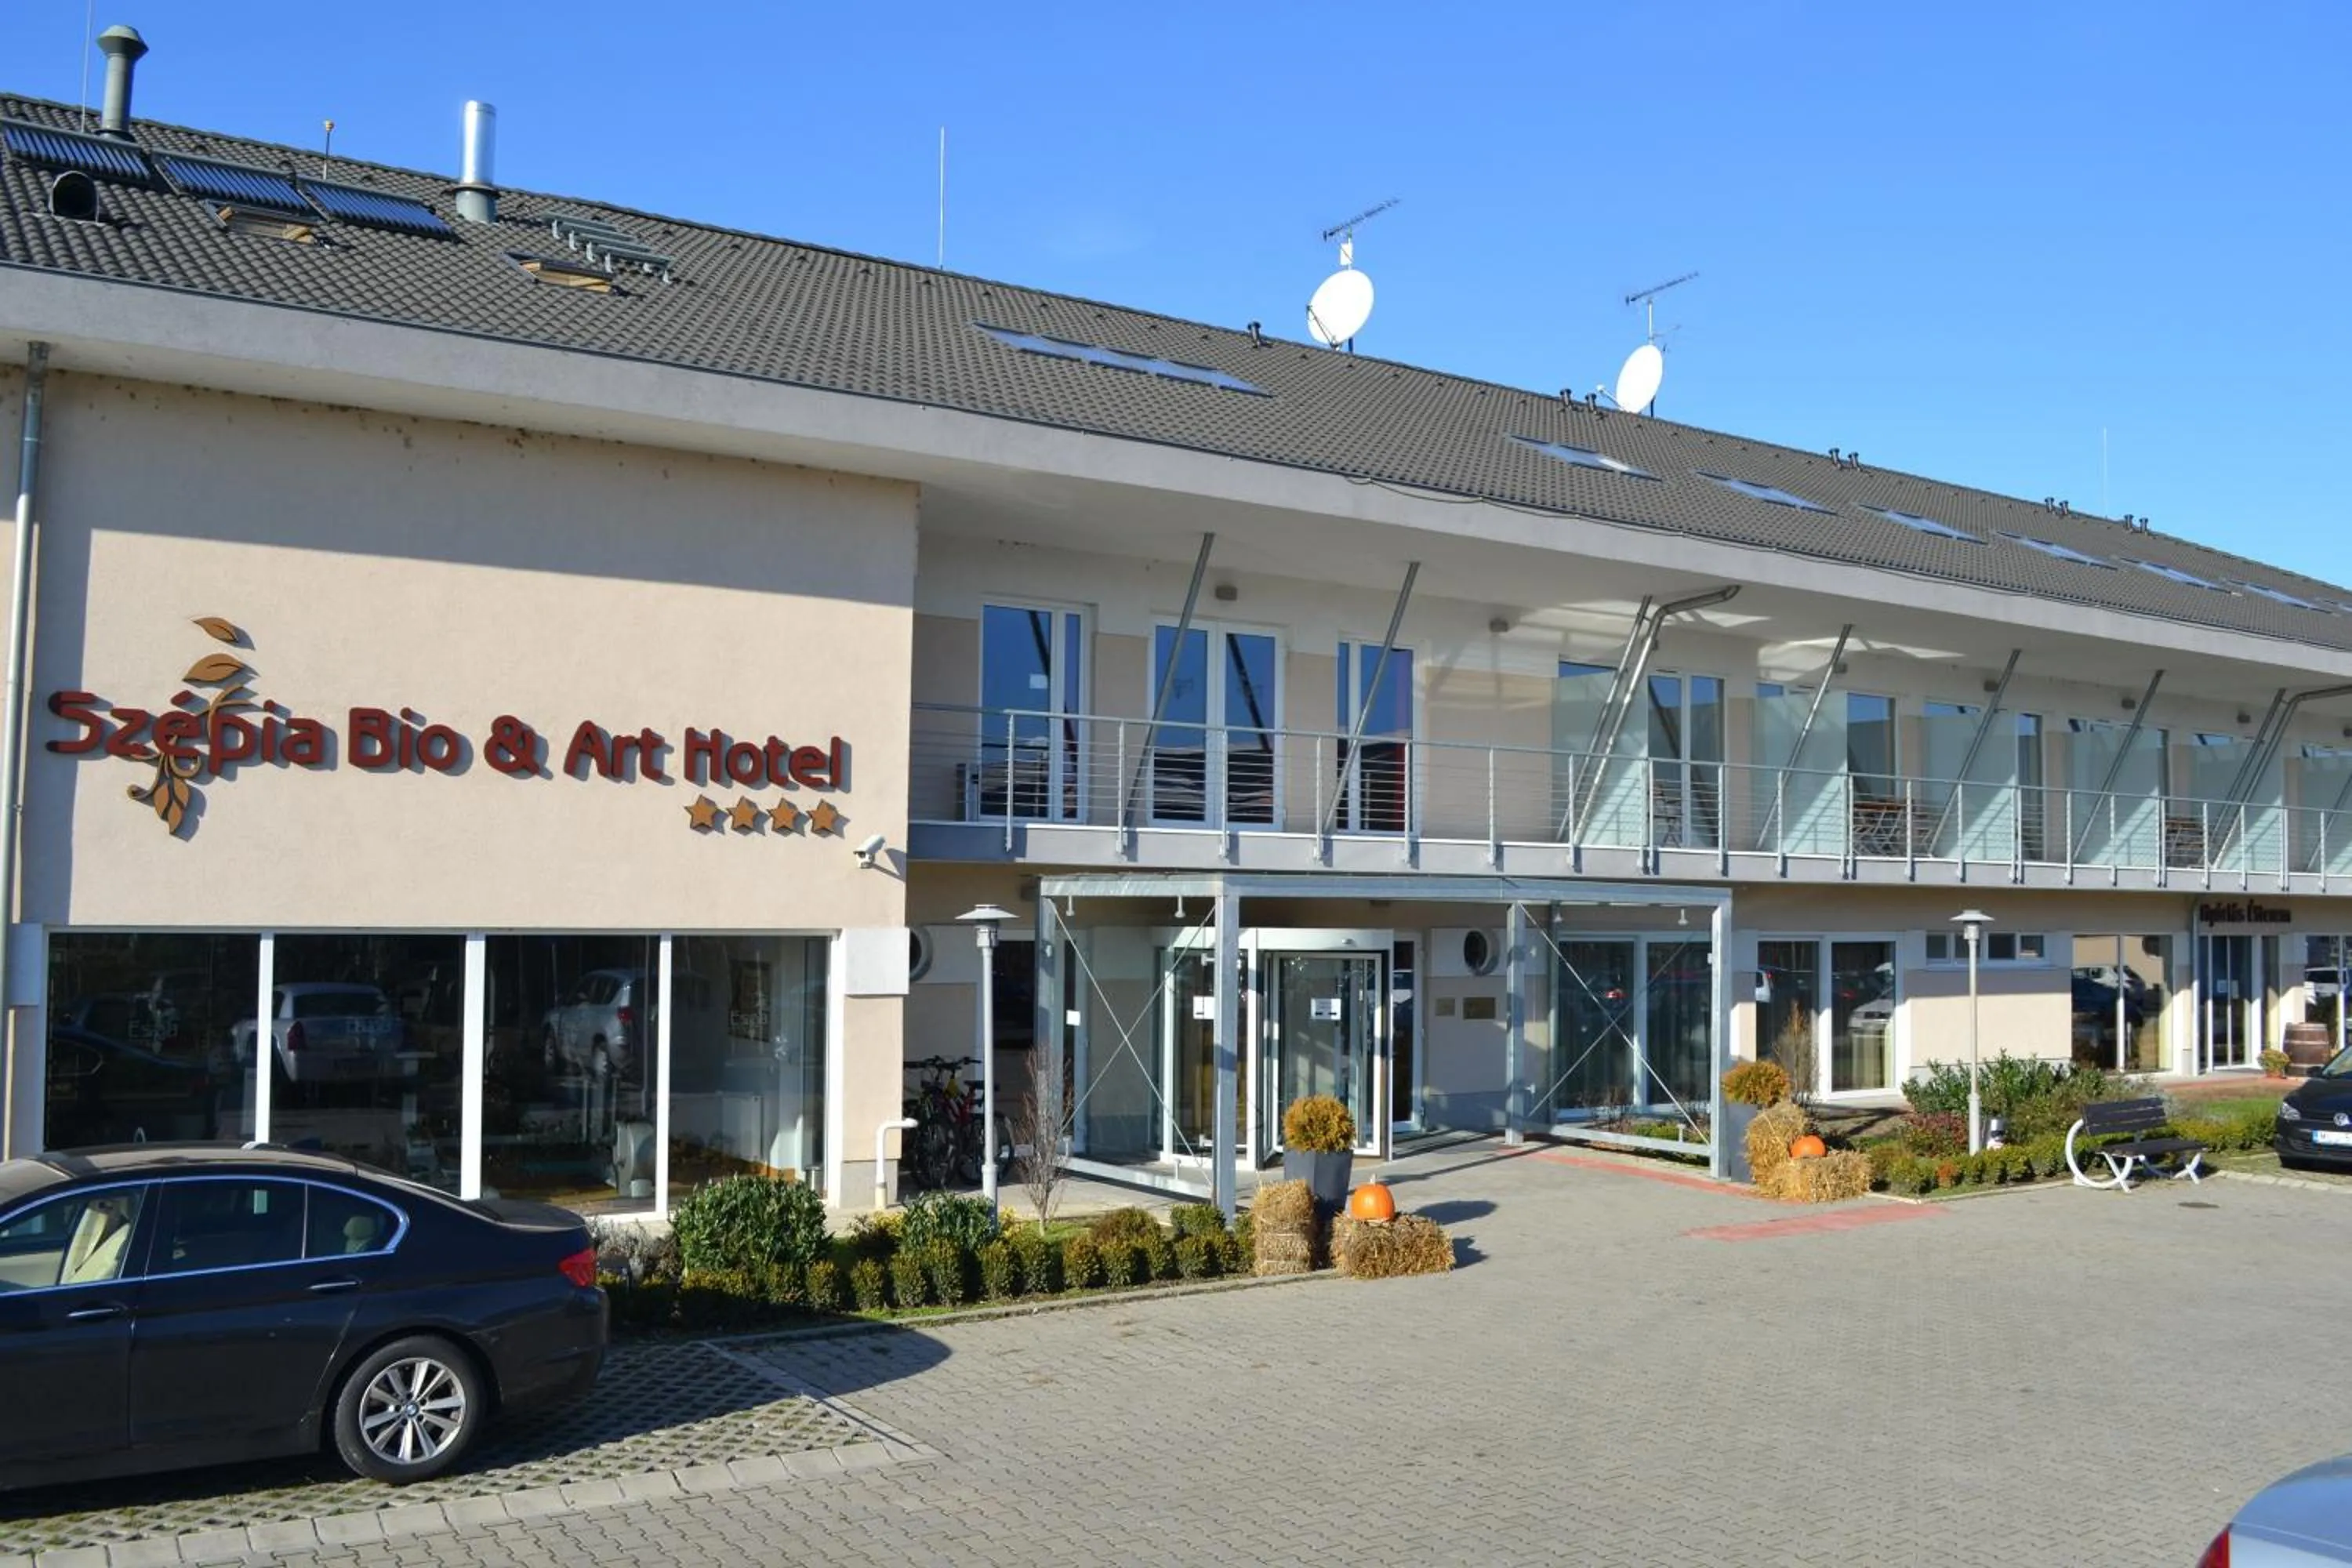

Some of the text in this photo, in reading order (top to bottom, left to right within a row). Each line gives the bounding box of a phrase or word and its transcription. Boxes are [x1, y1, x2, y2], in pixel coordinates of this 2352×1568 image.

[45, 690, 843, 789] Szépia Bio & Art Hotel
